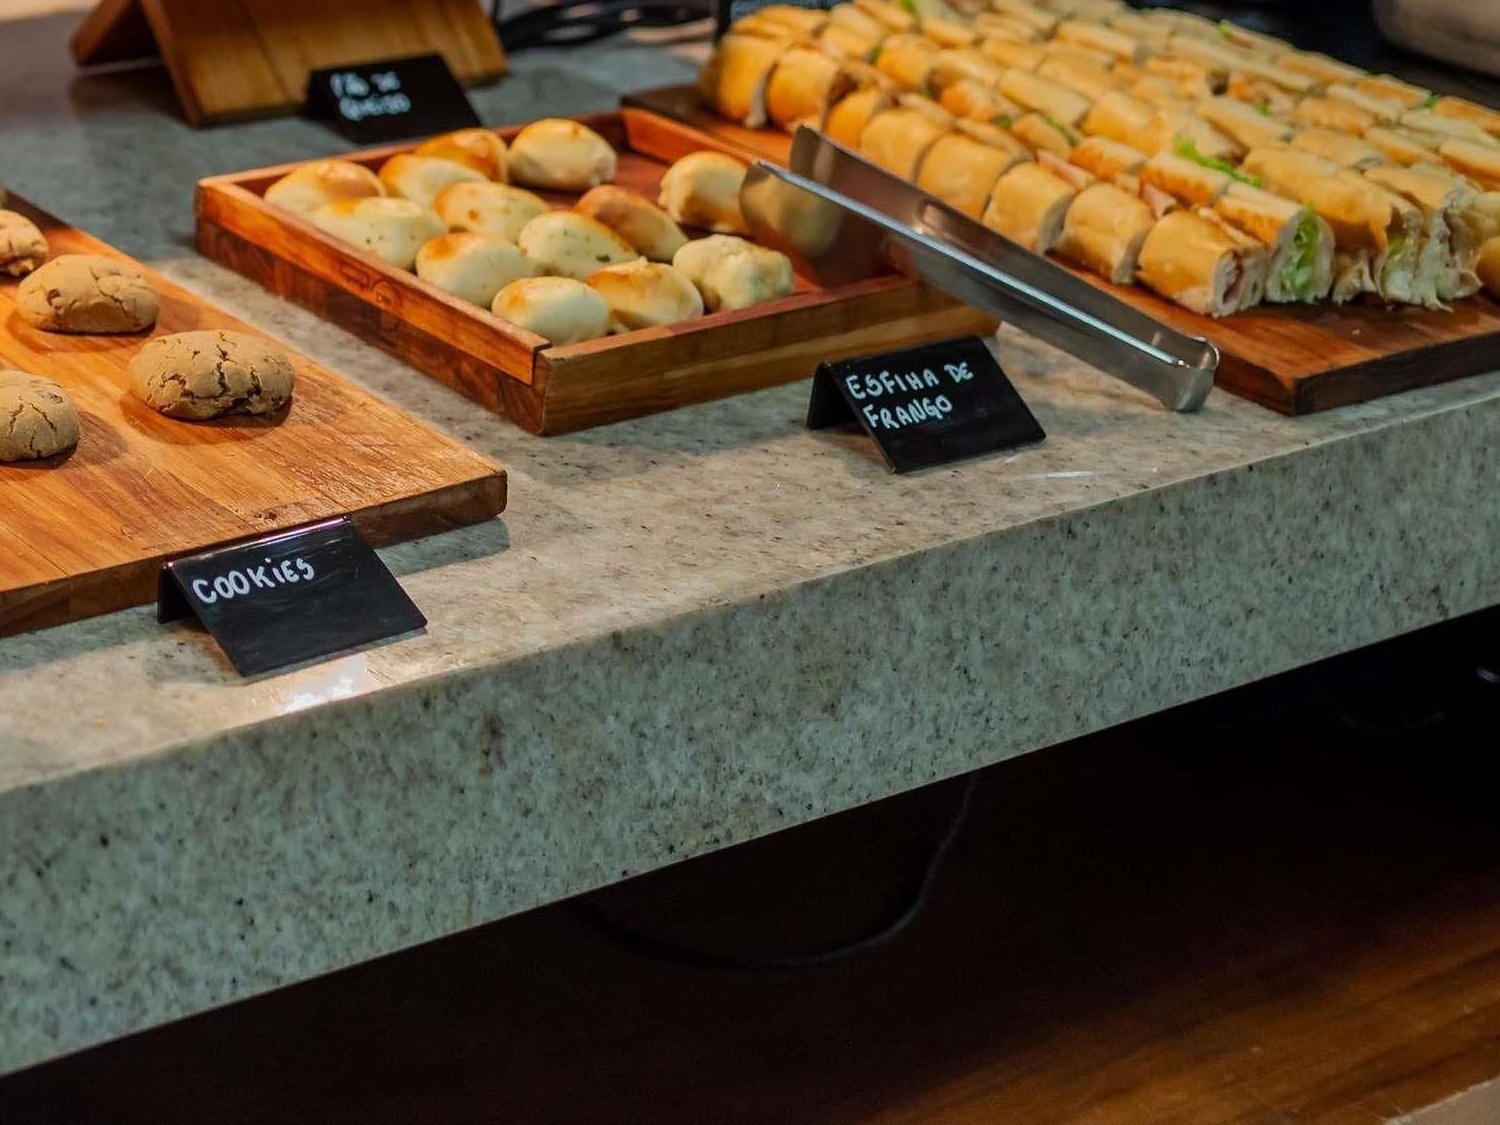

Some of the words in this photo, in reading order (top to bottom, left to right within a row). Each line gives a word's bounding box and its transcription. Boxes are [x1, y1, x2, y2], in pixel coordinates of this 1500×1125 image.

[845, 368, 940, 399] ESFIHA
[943, 362, 974, 383] DE
[862, 395, 952, 429] FRANGO
